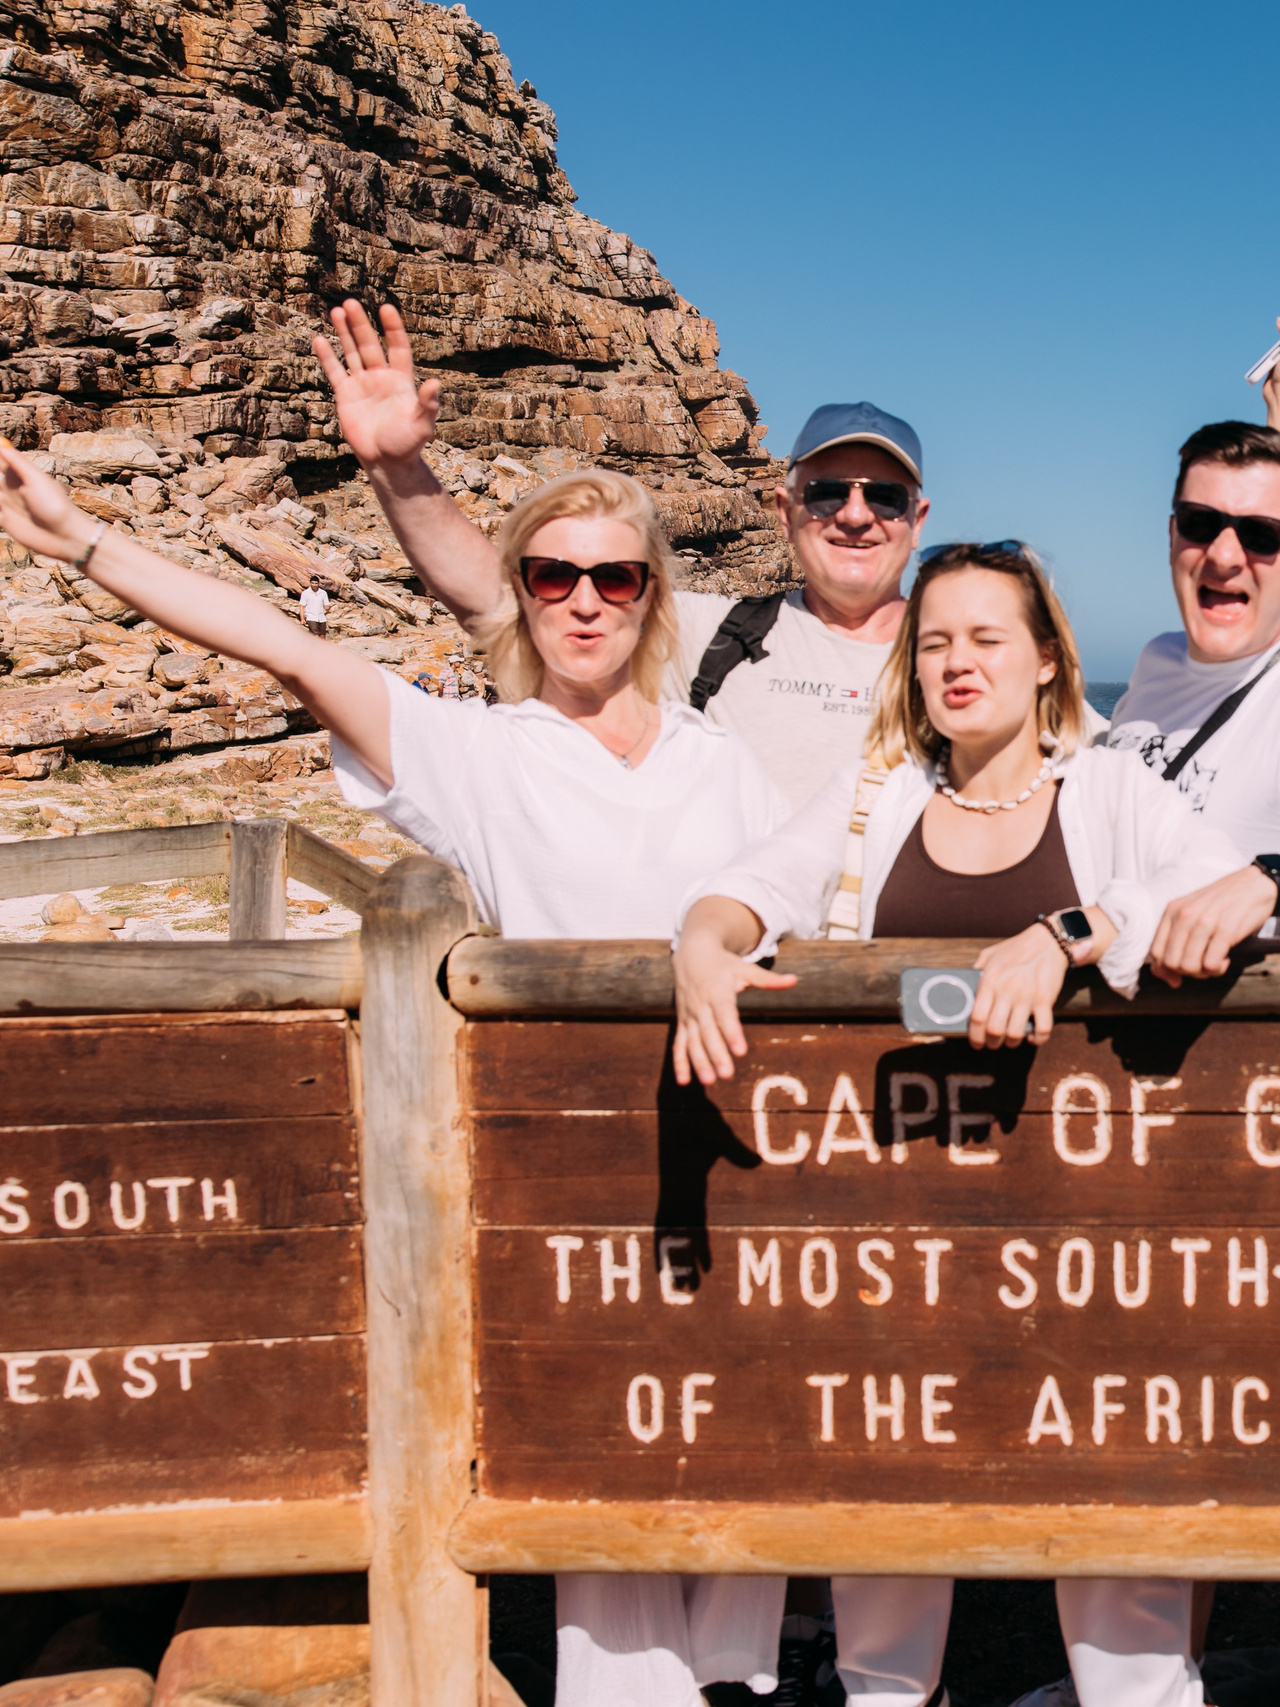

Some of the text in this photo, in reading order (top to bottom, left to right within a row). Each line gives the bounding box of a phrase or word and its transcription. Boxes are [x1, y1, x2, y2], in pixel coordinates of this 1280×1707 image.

[767, 679, 836, 698] TOMMY
[752, 1074, 999, 1165] CAPE
[1052, 1073, 1182, 1166] OF
[0, 1177, 238, 1234] SOUTH
[546, 1235, 695, 1305] THE
[737, 1237, 953, 1308] MOST
[6, 1350, 209, 1404] EAST
[627, 1372, 716, 1443] OF
[806, 1373, 958, 1443] THE
